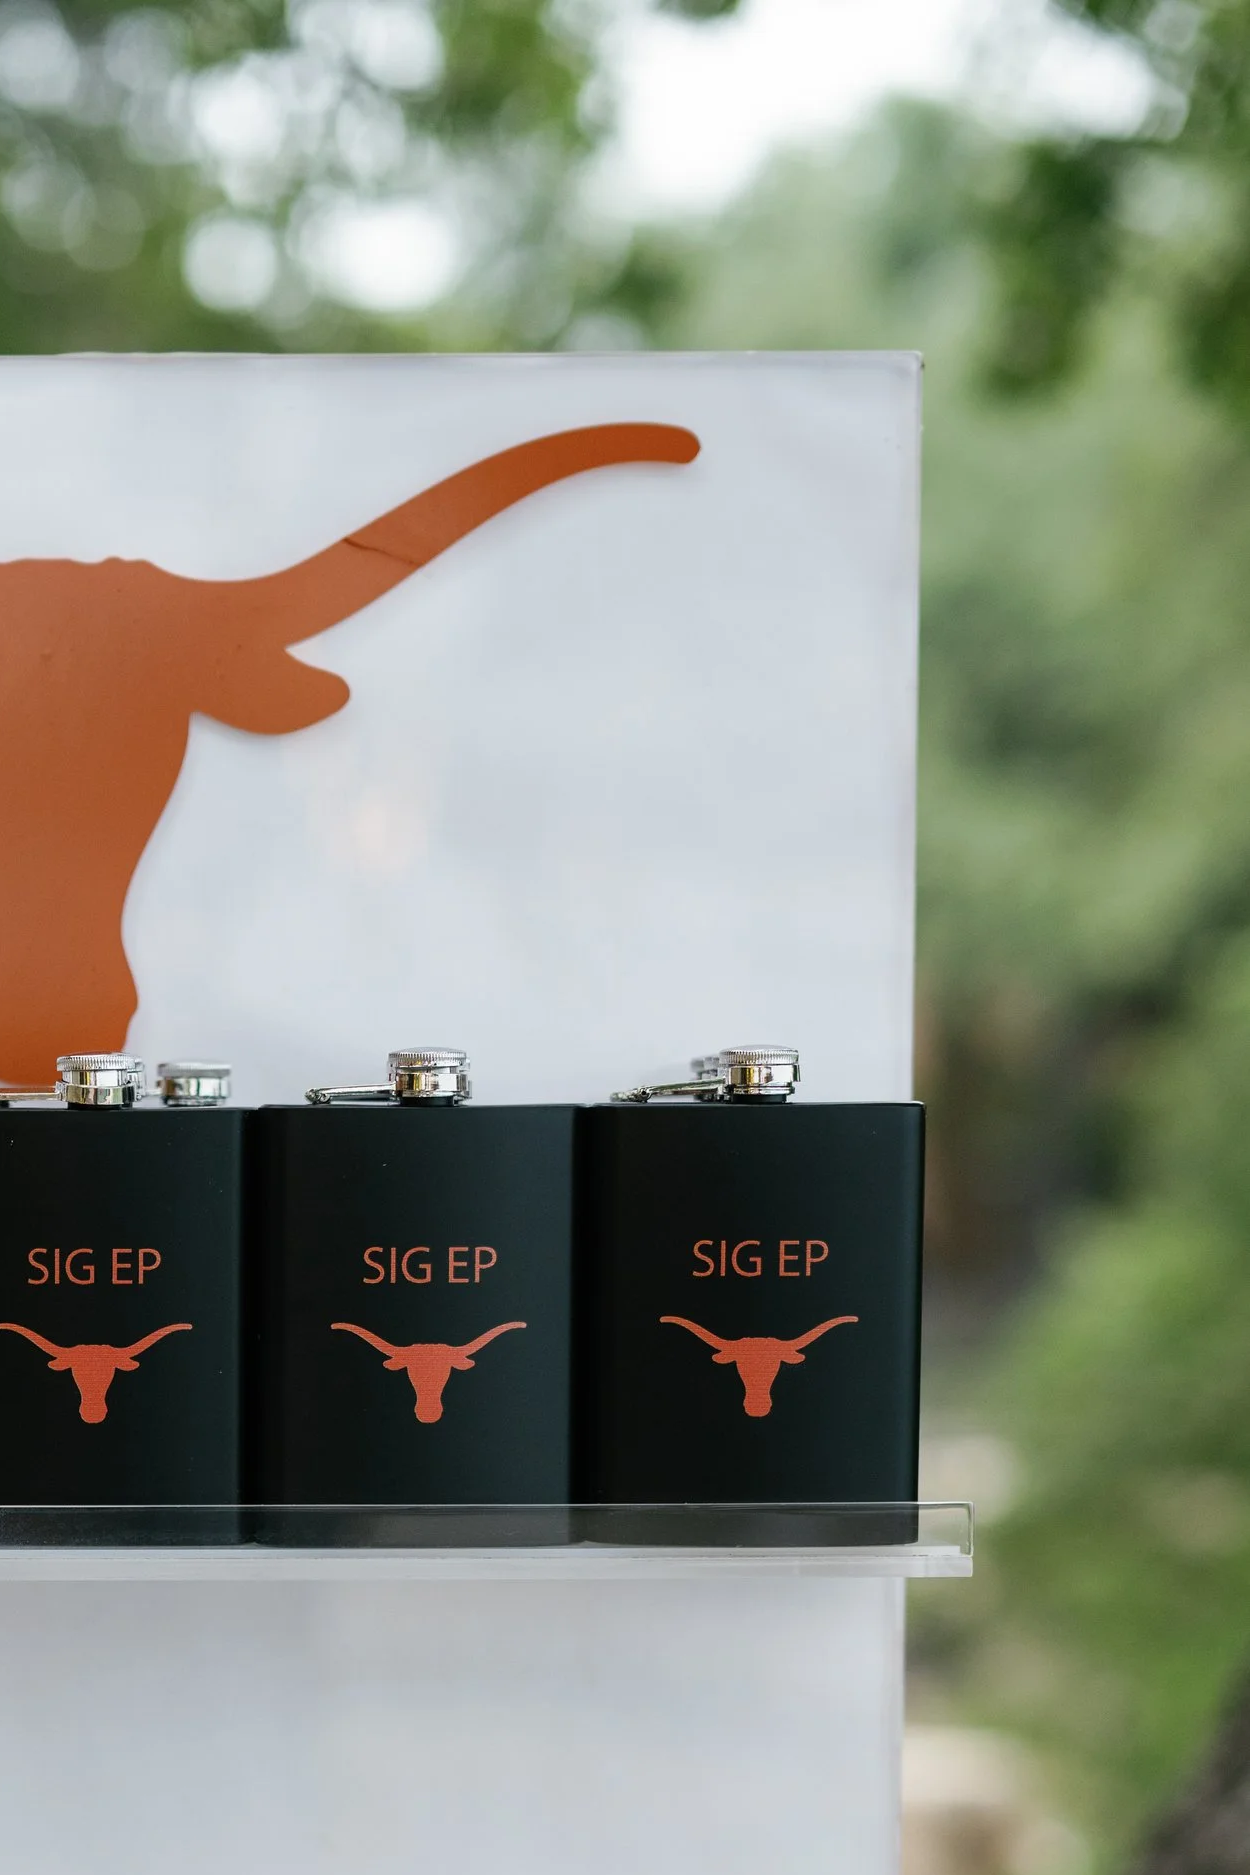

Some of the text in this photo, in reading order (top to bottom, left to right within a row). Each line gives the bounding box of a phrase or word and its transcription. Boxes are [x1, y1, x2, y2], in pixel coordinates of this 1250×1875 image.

[27, 1247, 162, 1286] SIG EP
[363, 1245, 498, 1285] SIG EP
[691, 1239, 829, 1278] SIG EP
